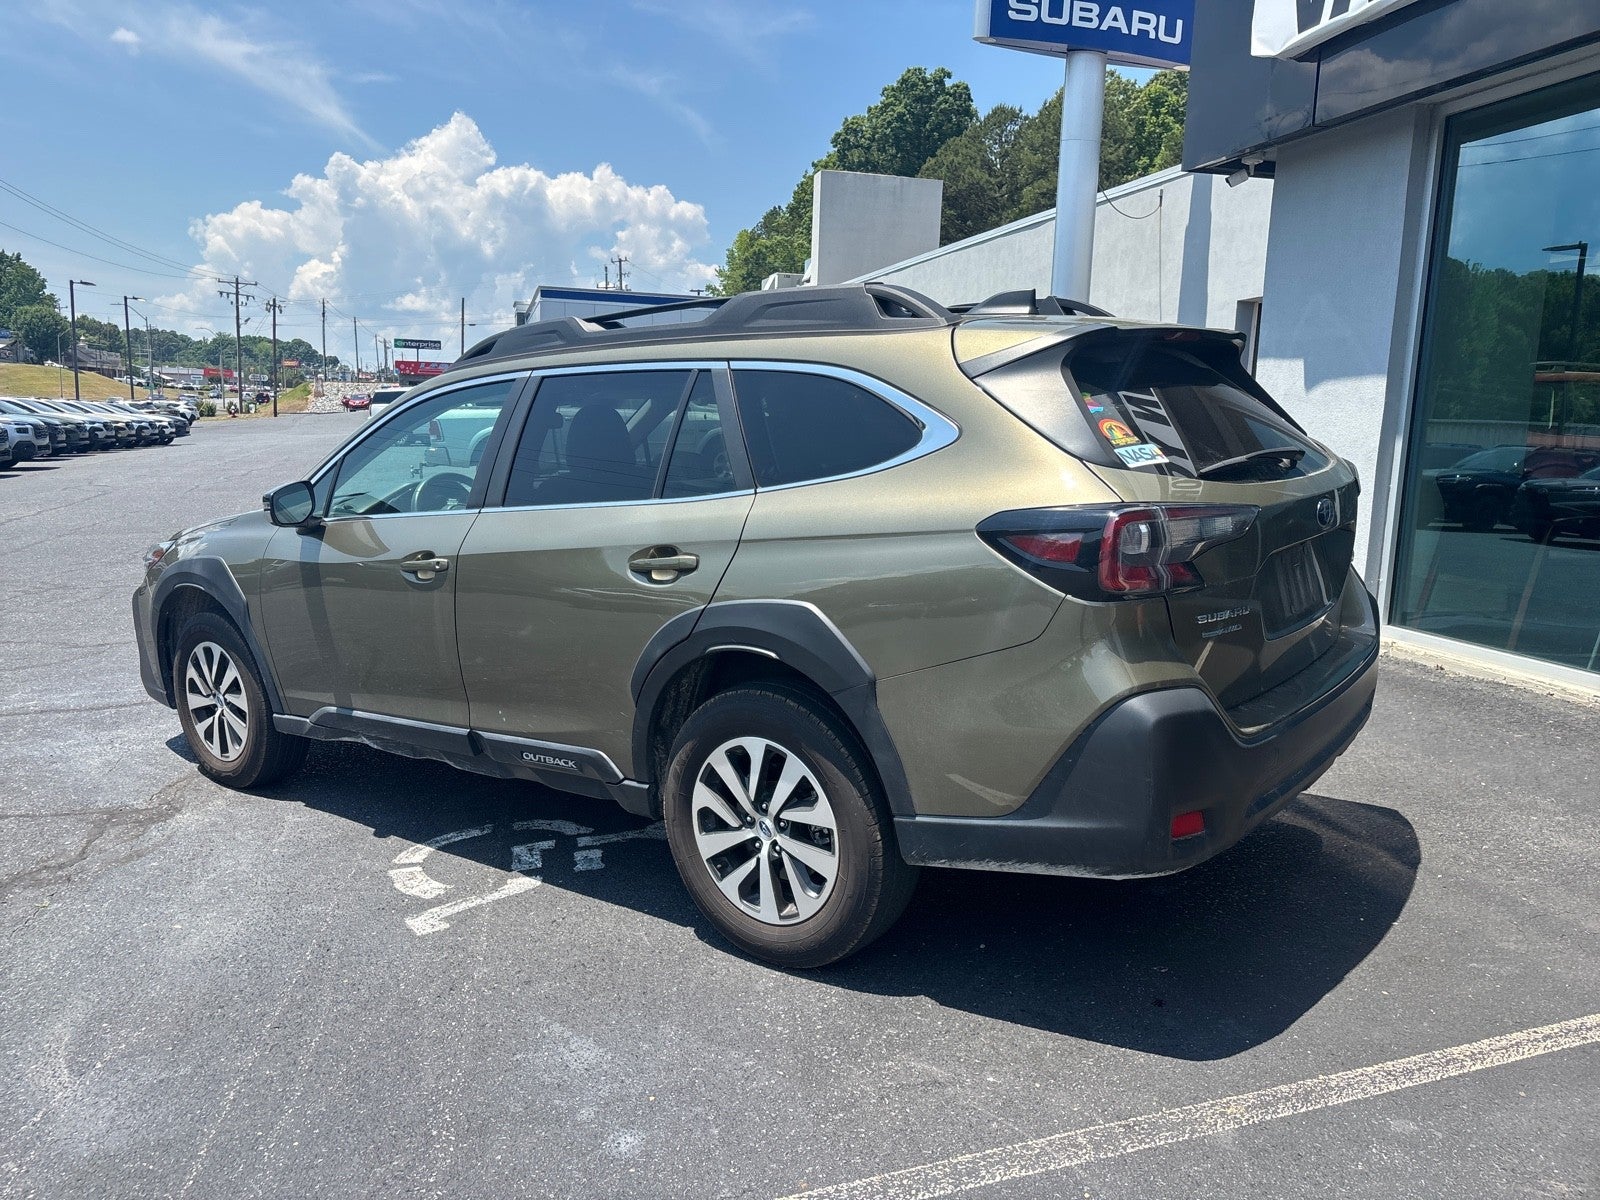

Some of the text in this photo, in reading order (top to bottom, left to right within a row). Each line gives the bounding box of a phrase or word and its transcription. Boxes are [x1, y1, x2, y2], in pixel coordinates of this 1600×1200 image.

[1007, 0, 1183, 45] SUBARU
[396, 340, 441, 348] enterprise
[1117, 447, 1163, 465] NASA
[1196, 606, 1251, 624] SUBARU
[522, 752, 577, 768] OUTBACK
